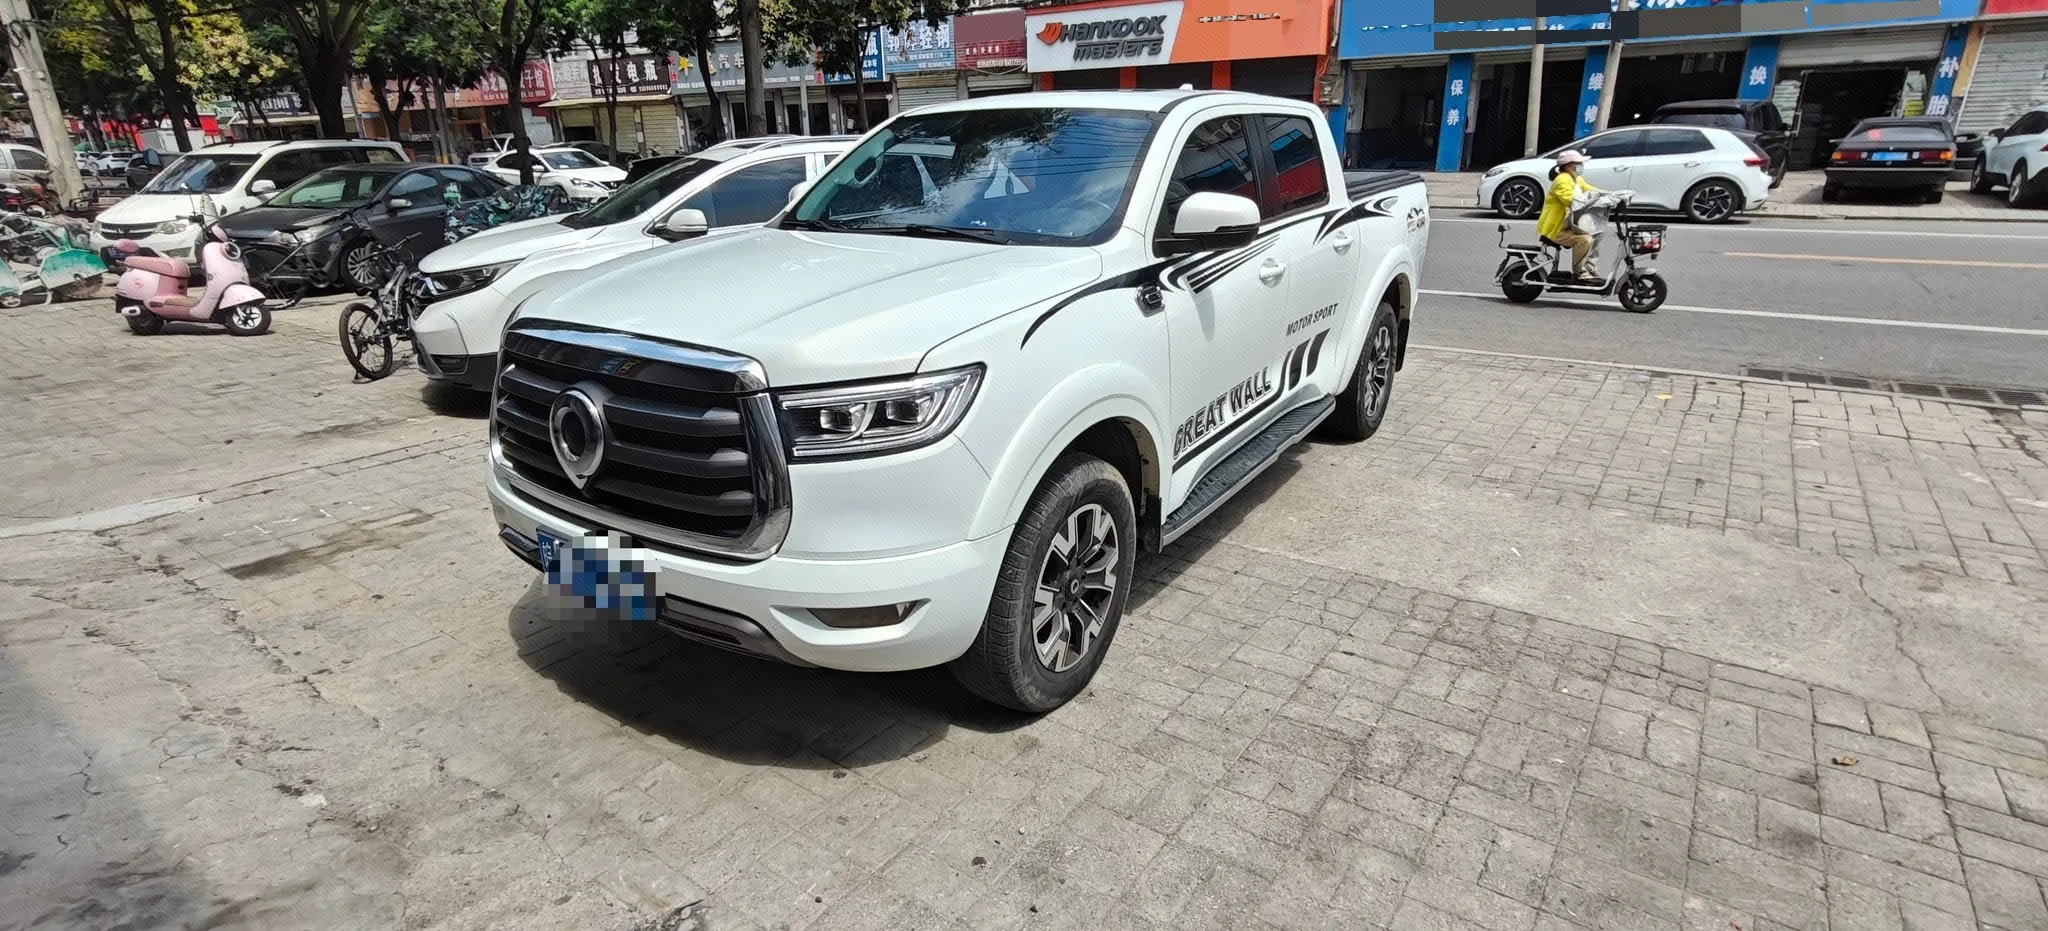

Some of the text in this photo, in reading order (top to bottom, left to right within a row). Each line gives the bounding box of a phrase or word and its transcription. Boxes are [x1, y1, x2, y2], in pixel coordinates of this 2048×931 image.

[1584, 72, 1605, 123] 维修
[1749, 65, 1767, 86] 换
[1926, 56, 1959, 116] 补胎
[1446, 79, 1464, 126] 保养
[1286, 302, 1338, 337] MOTOR SPORT
[1173, 366, 1272, 460] GREAT WALL
